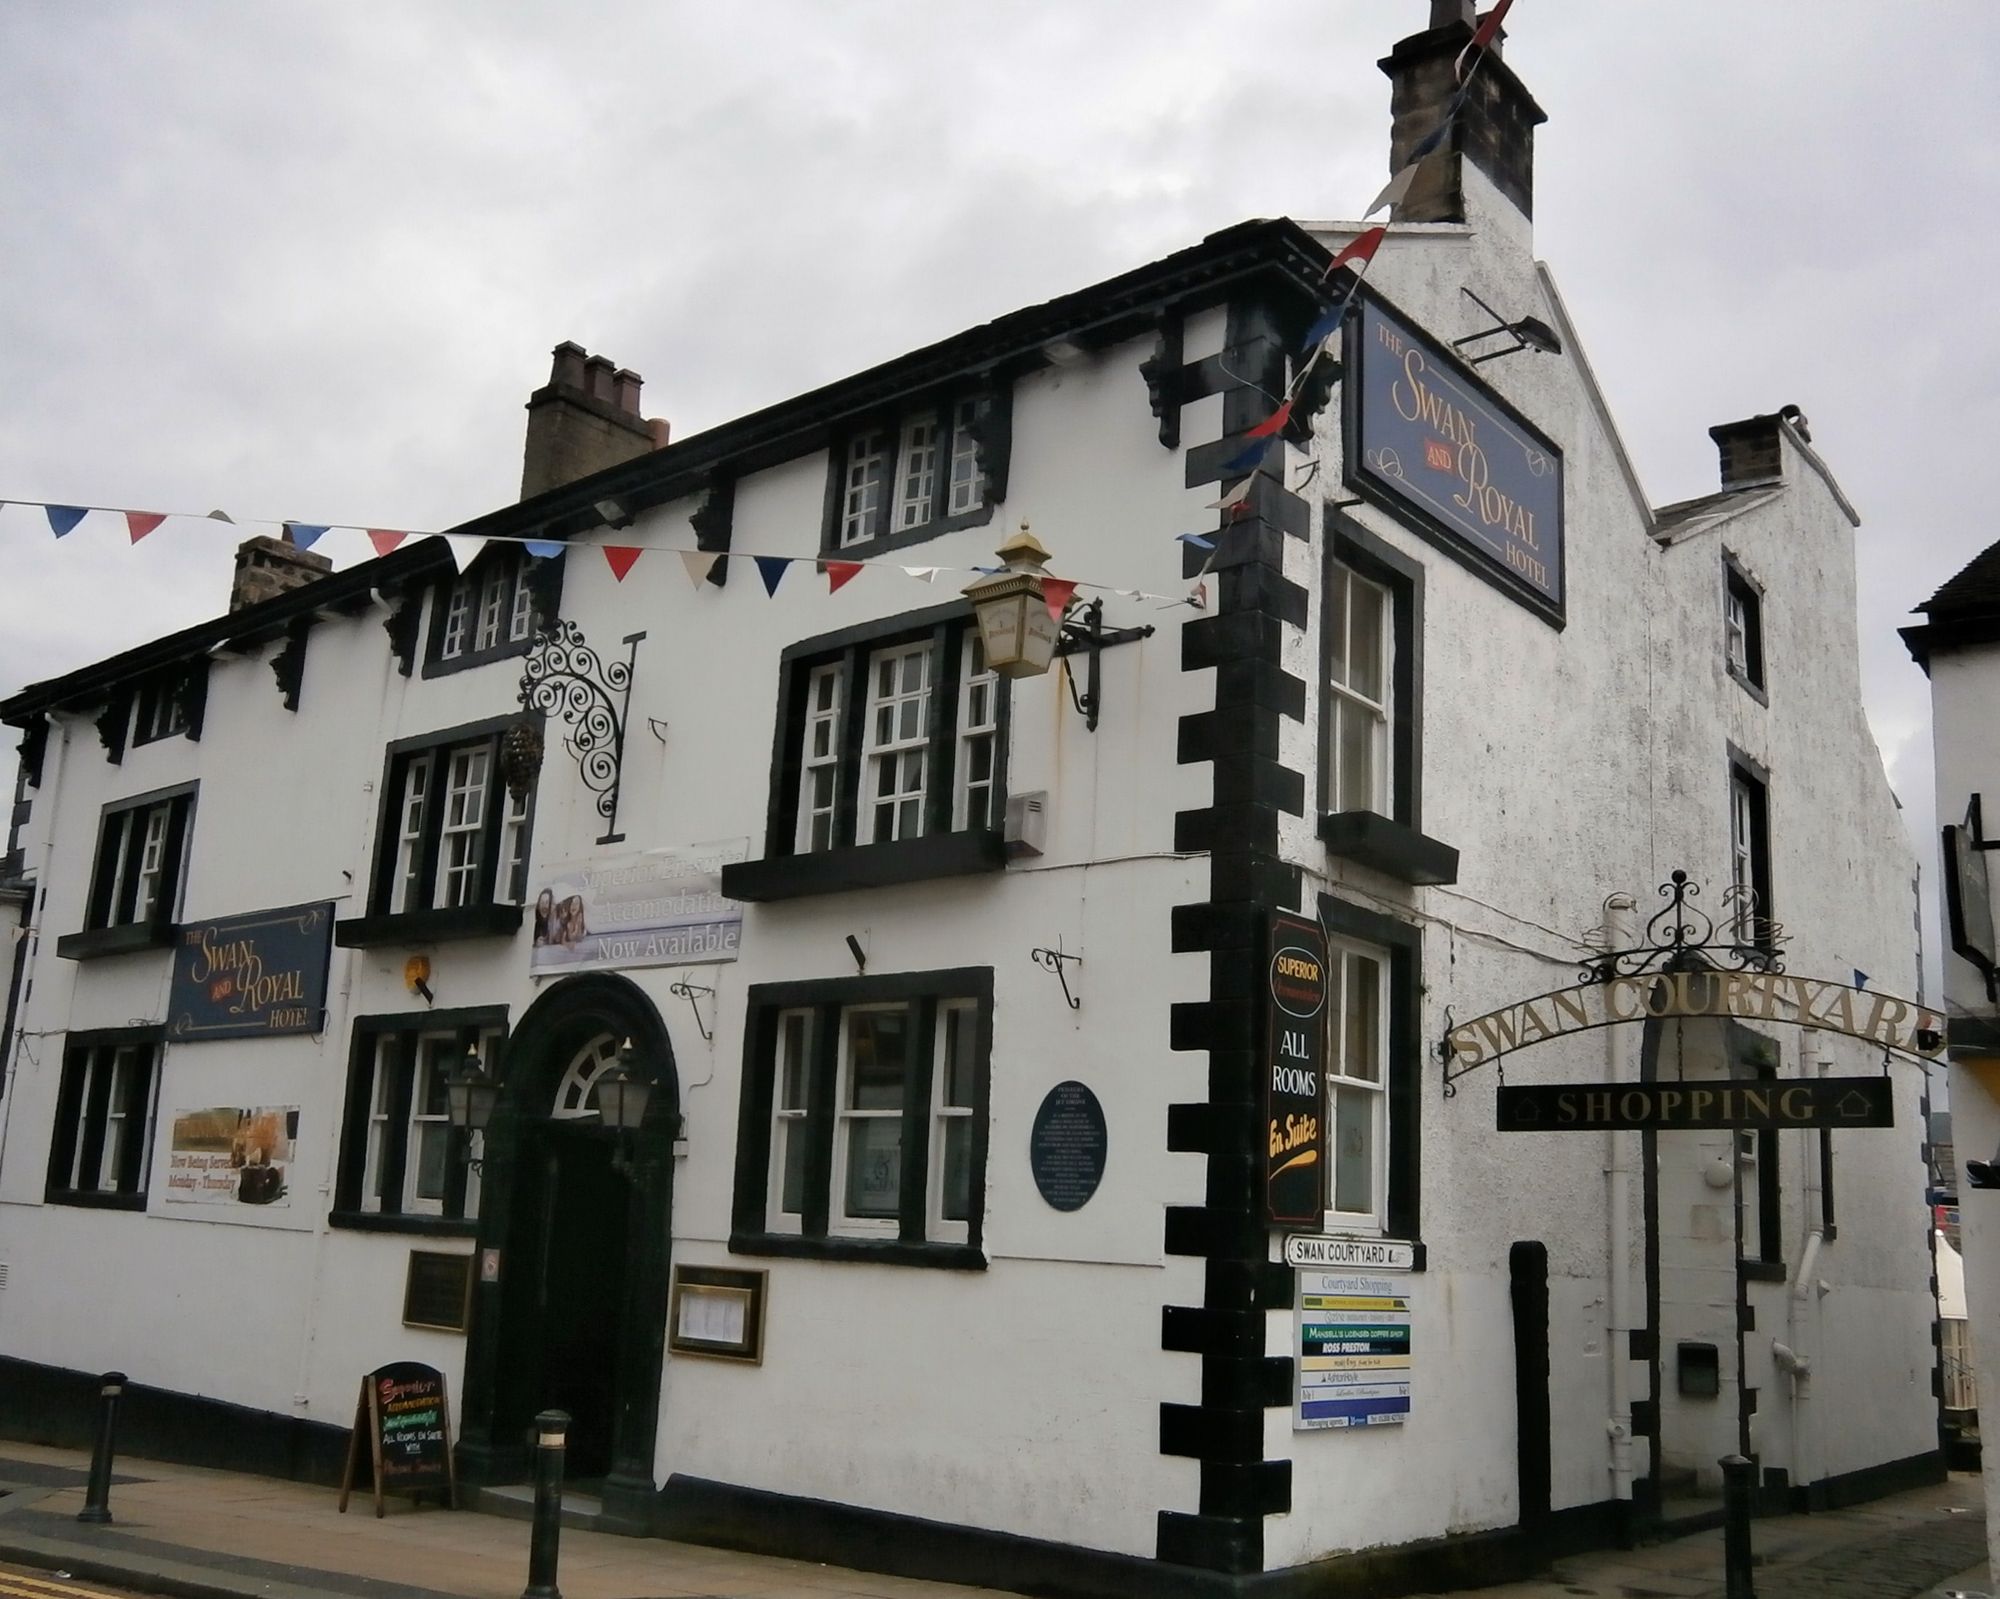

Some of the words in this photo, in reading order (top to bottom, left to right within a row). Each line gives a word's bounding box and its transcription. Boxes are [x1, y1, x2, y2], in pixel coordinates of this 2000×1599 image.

[1377, 322, 1402, 358] THE
[1392, 349, 1476, 454] SWAN
[1427, 446, 1452, 470] AND
[1453, 442, 1540, 551] ROYAL
[1505, 541, 1550, 590] HOTEL
[186, 930, 203, 945] THE
[192, 926, 255, 983] SWAN
[598, 937, 641, 961] Now
[645, 924, 737, 957] Available
[229, 955, 305, 1014] ROYAL
[1277, 955, 1319, 982] SUPERIOR
[1449, 985, 1594, 1068] SWAN
[1280, 1031, 1309, 1059] ALL
[1272, 1066, 1316, 1097] ROOMS
[1558, 1087, 1815, 1121] SHOPPING
[1269, 1119, 1284, 1158] En
[1285, 1113, 1317, 1150] Suite
[1296, 1241, 1324, 1260] SWAN
[1328, 1243, 1385, 1263] COURTYARD
[1322, 1276, 1358, 1293] Courtyard
[1360, 1277, 1393, 1294] Shopping
[1322, 1342, 1341, 1354] ROSS
[1341, 1342, 1370, 1353] PRESTON
[382, 1433, 395, 1444] ALL
[396, 1431, 416, 1442] ROOMS
[427, 1430, 443, 1441] SUITE
